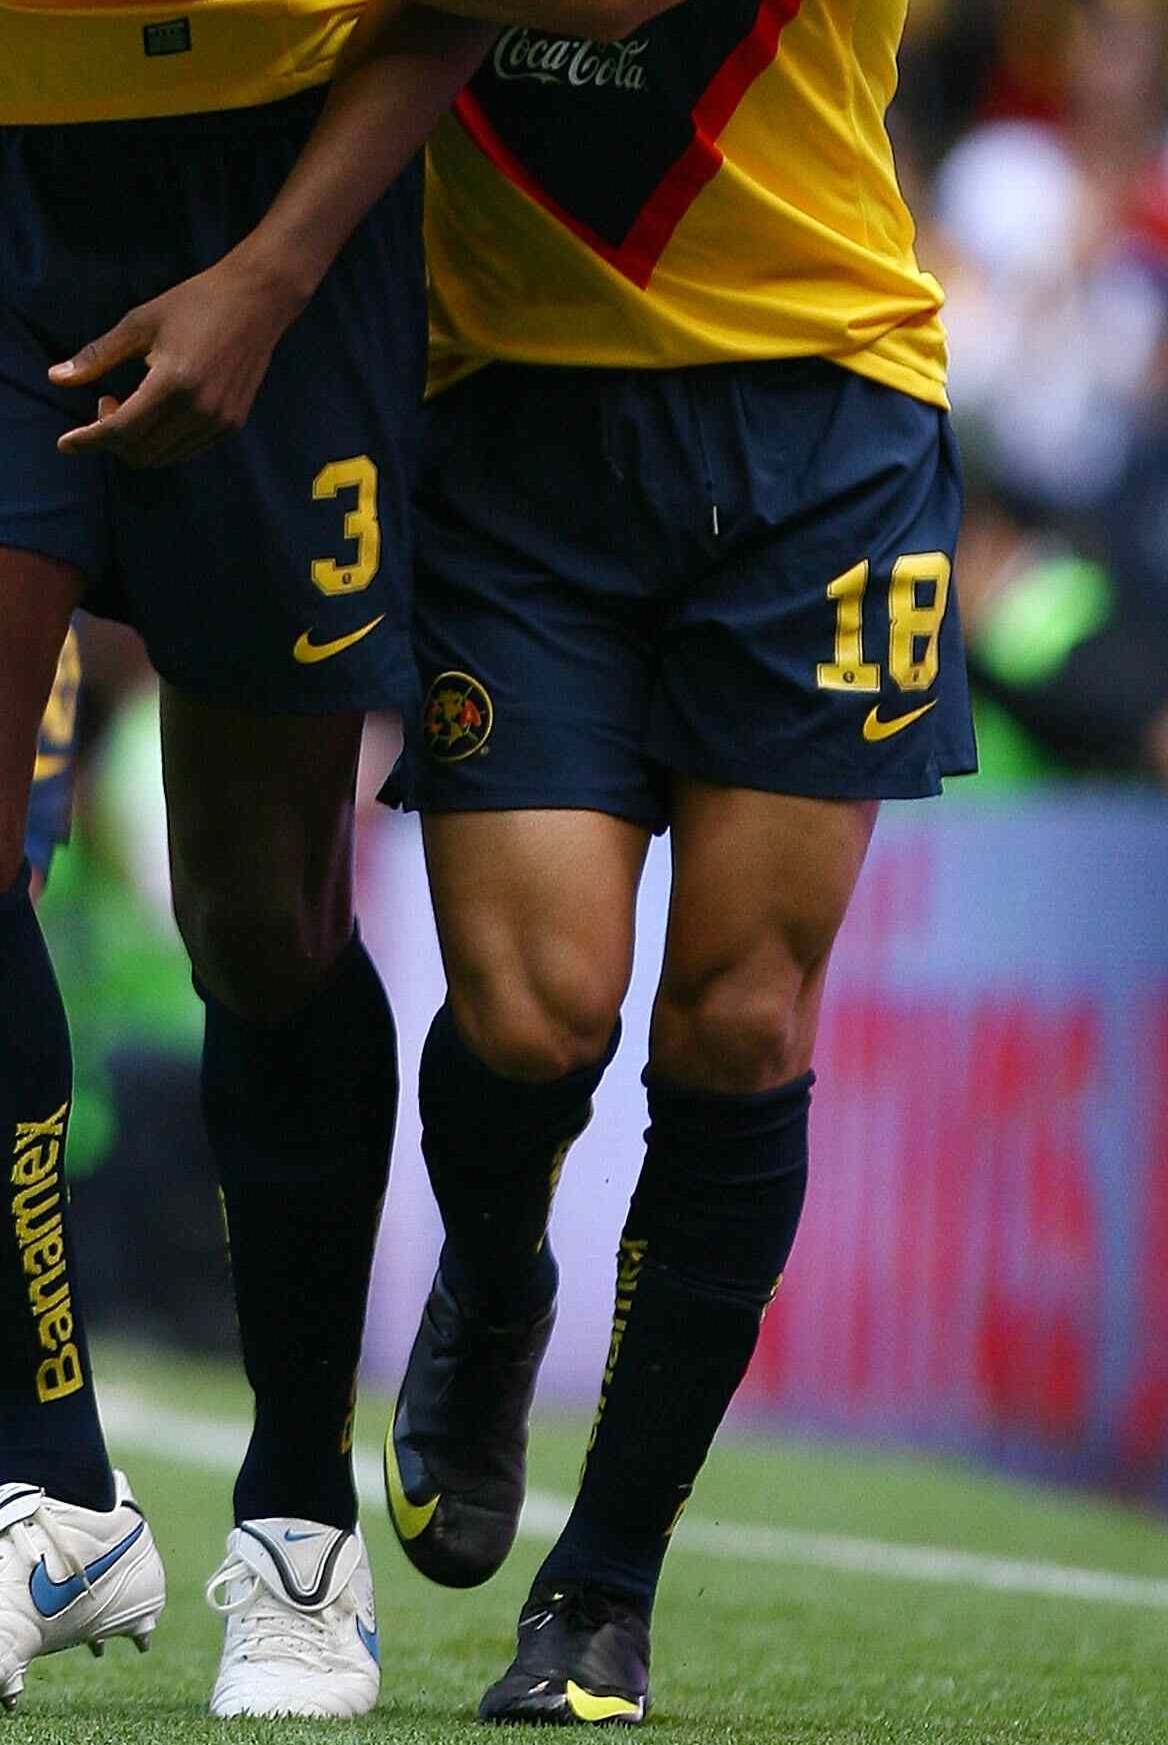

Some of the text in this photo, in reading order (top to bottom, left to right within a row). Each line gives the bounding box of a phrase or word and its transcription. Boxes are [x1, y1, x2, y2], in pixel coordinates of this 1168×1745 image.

[311, 455, 380, 596] 3
[816, 551, 952, 692] 18
[11, 1101, 84, 1403] Banamex
